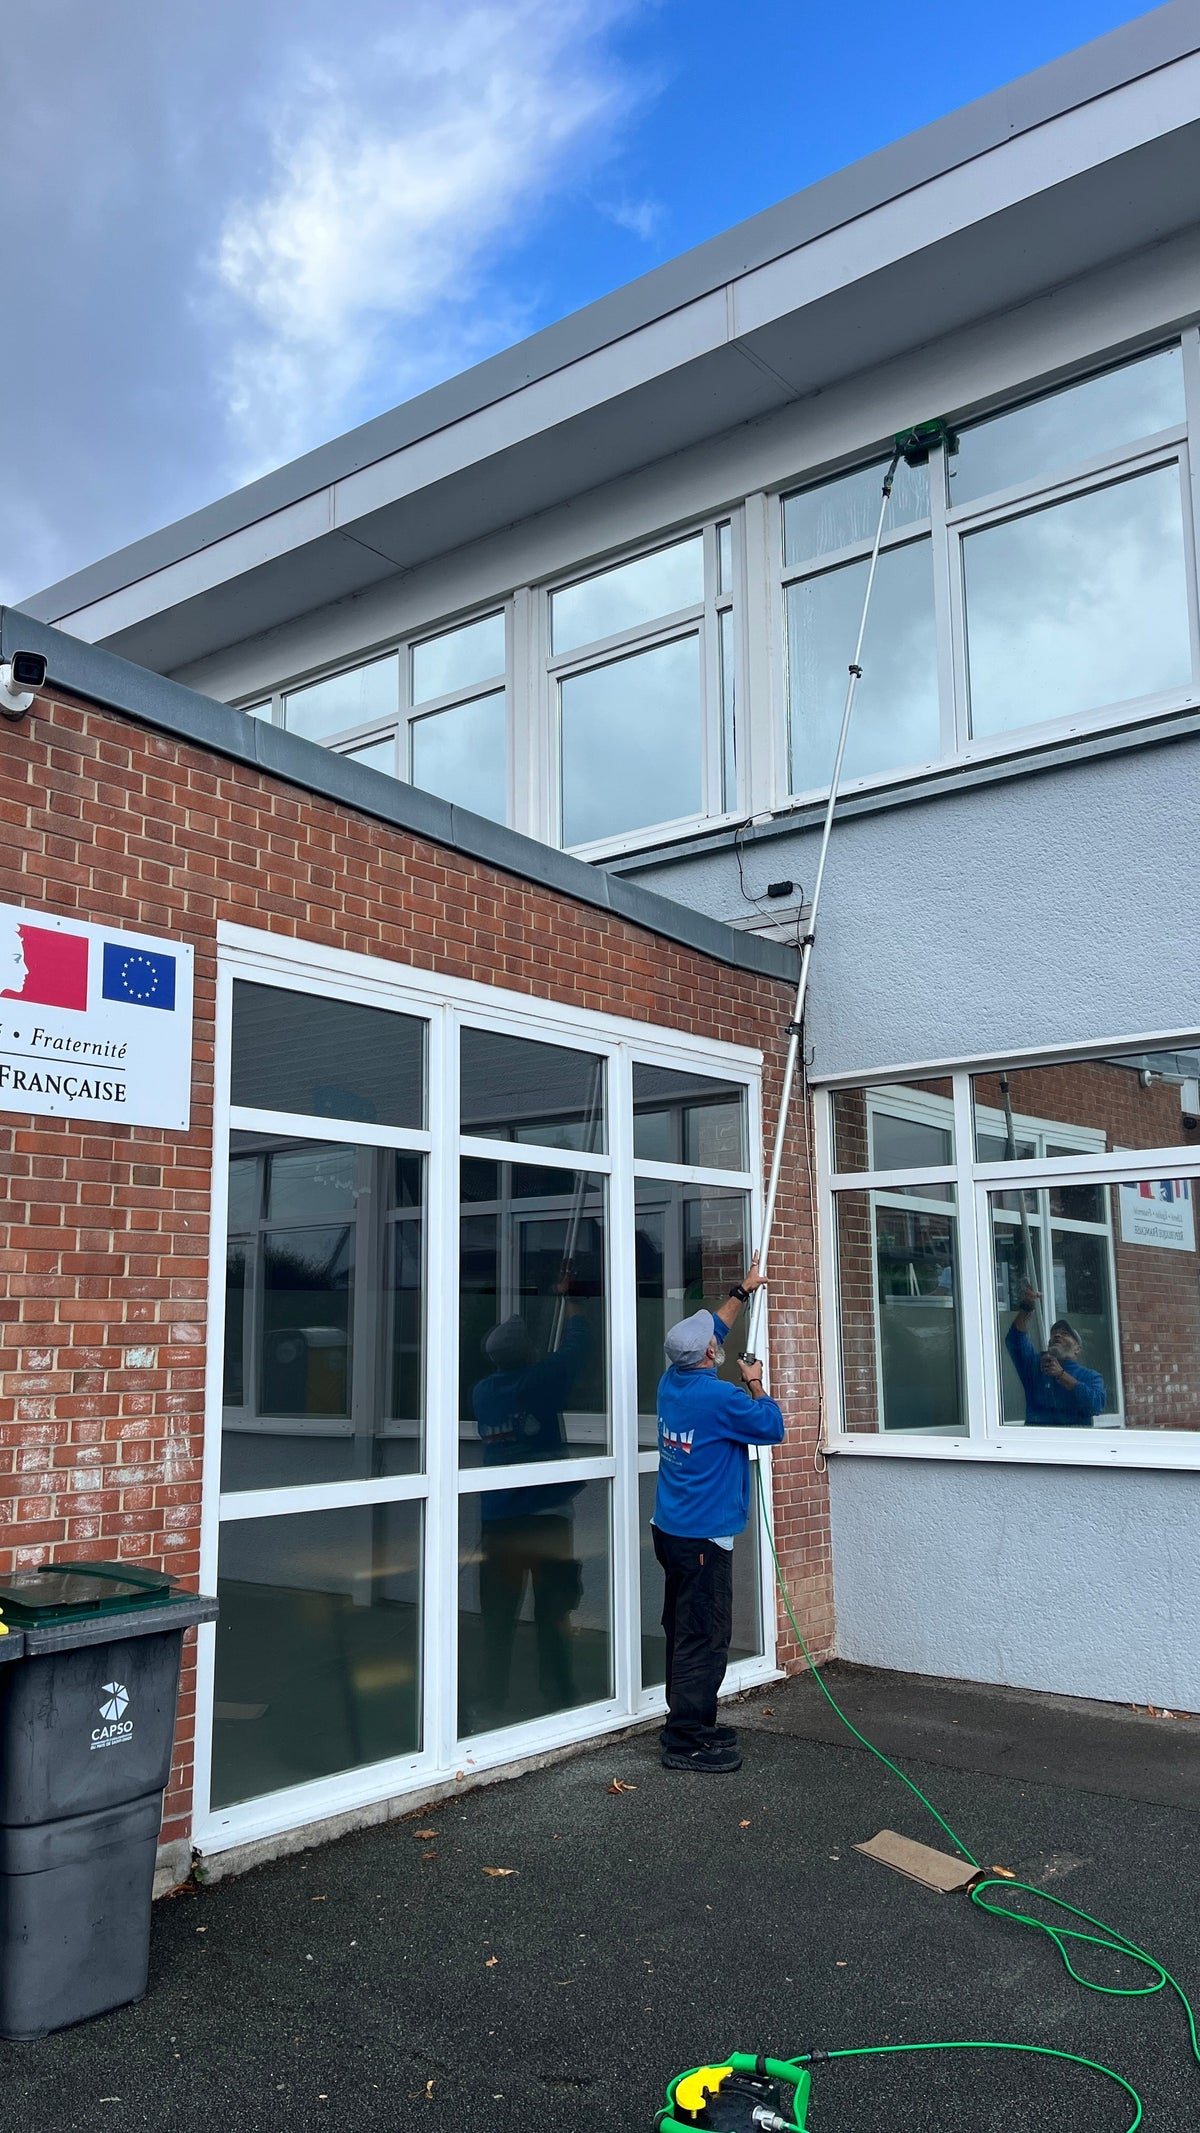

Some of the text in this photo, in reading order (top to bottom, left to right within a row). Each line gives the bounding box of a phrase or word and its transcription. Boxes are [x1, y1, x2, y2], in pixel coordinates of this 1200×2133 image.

[30, 1027, 128, 1059] Fraternité
[0, 1064, 126, 1102] FRANÇAISE
[91, 1720, 133, 1741] CAPSO
